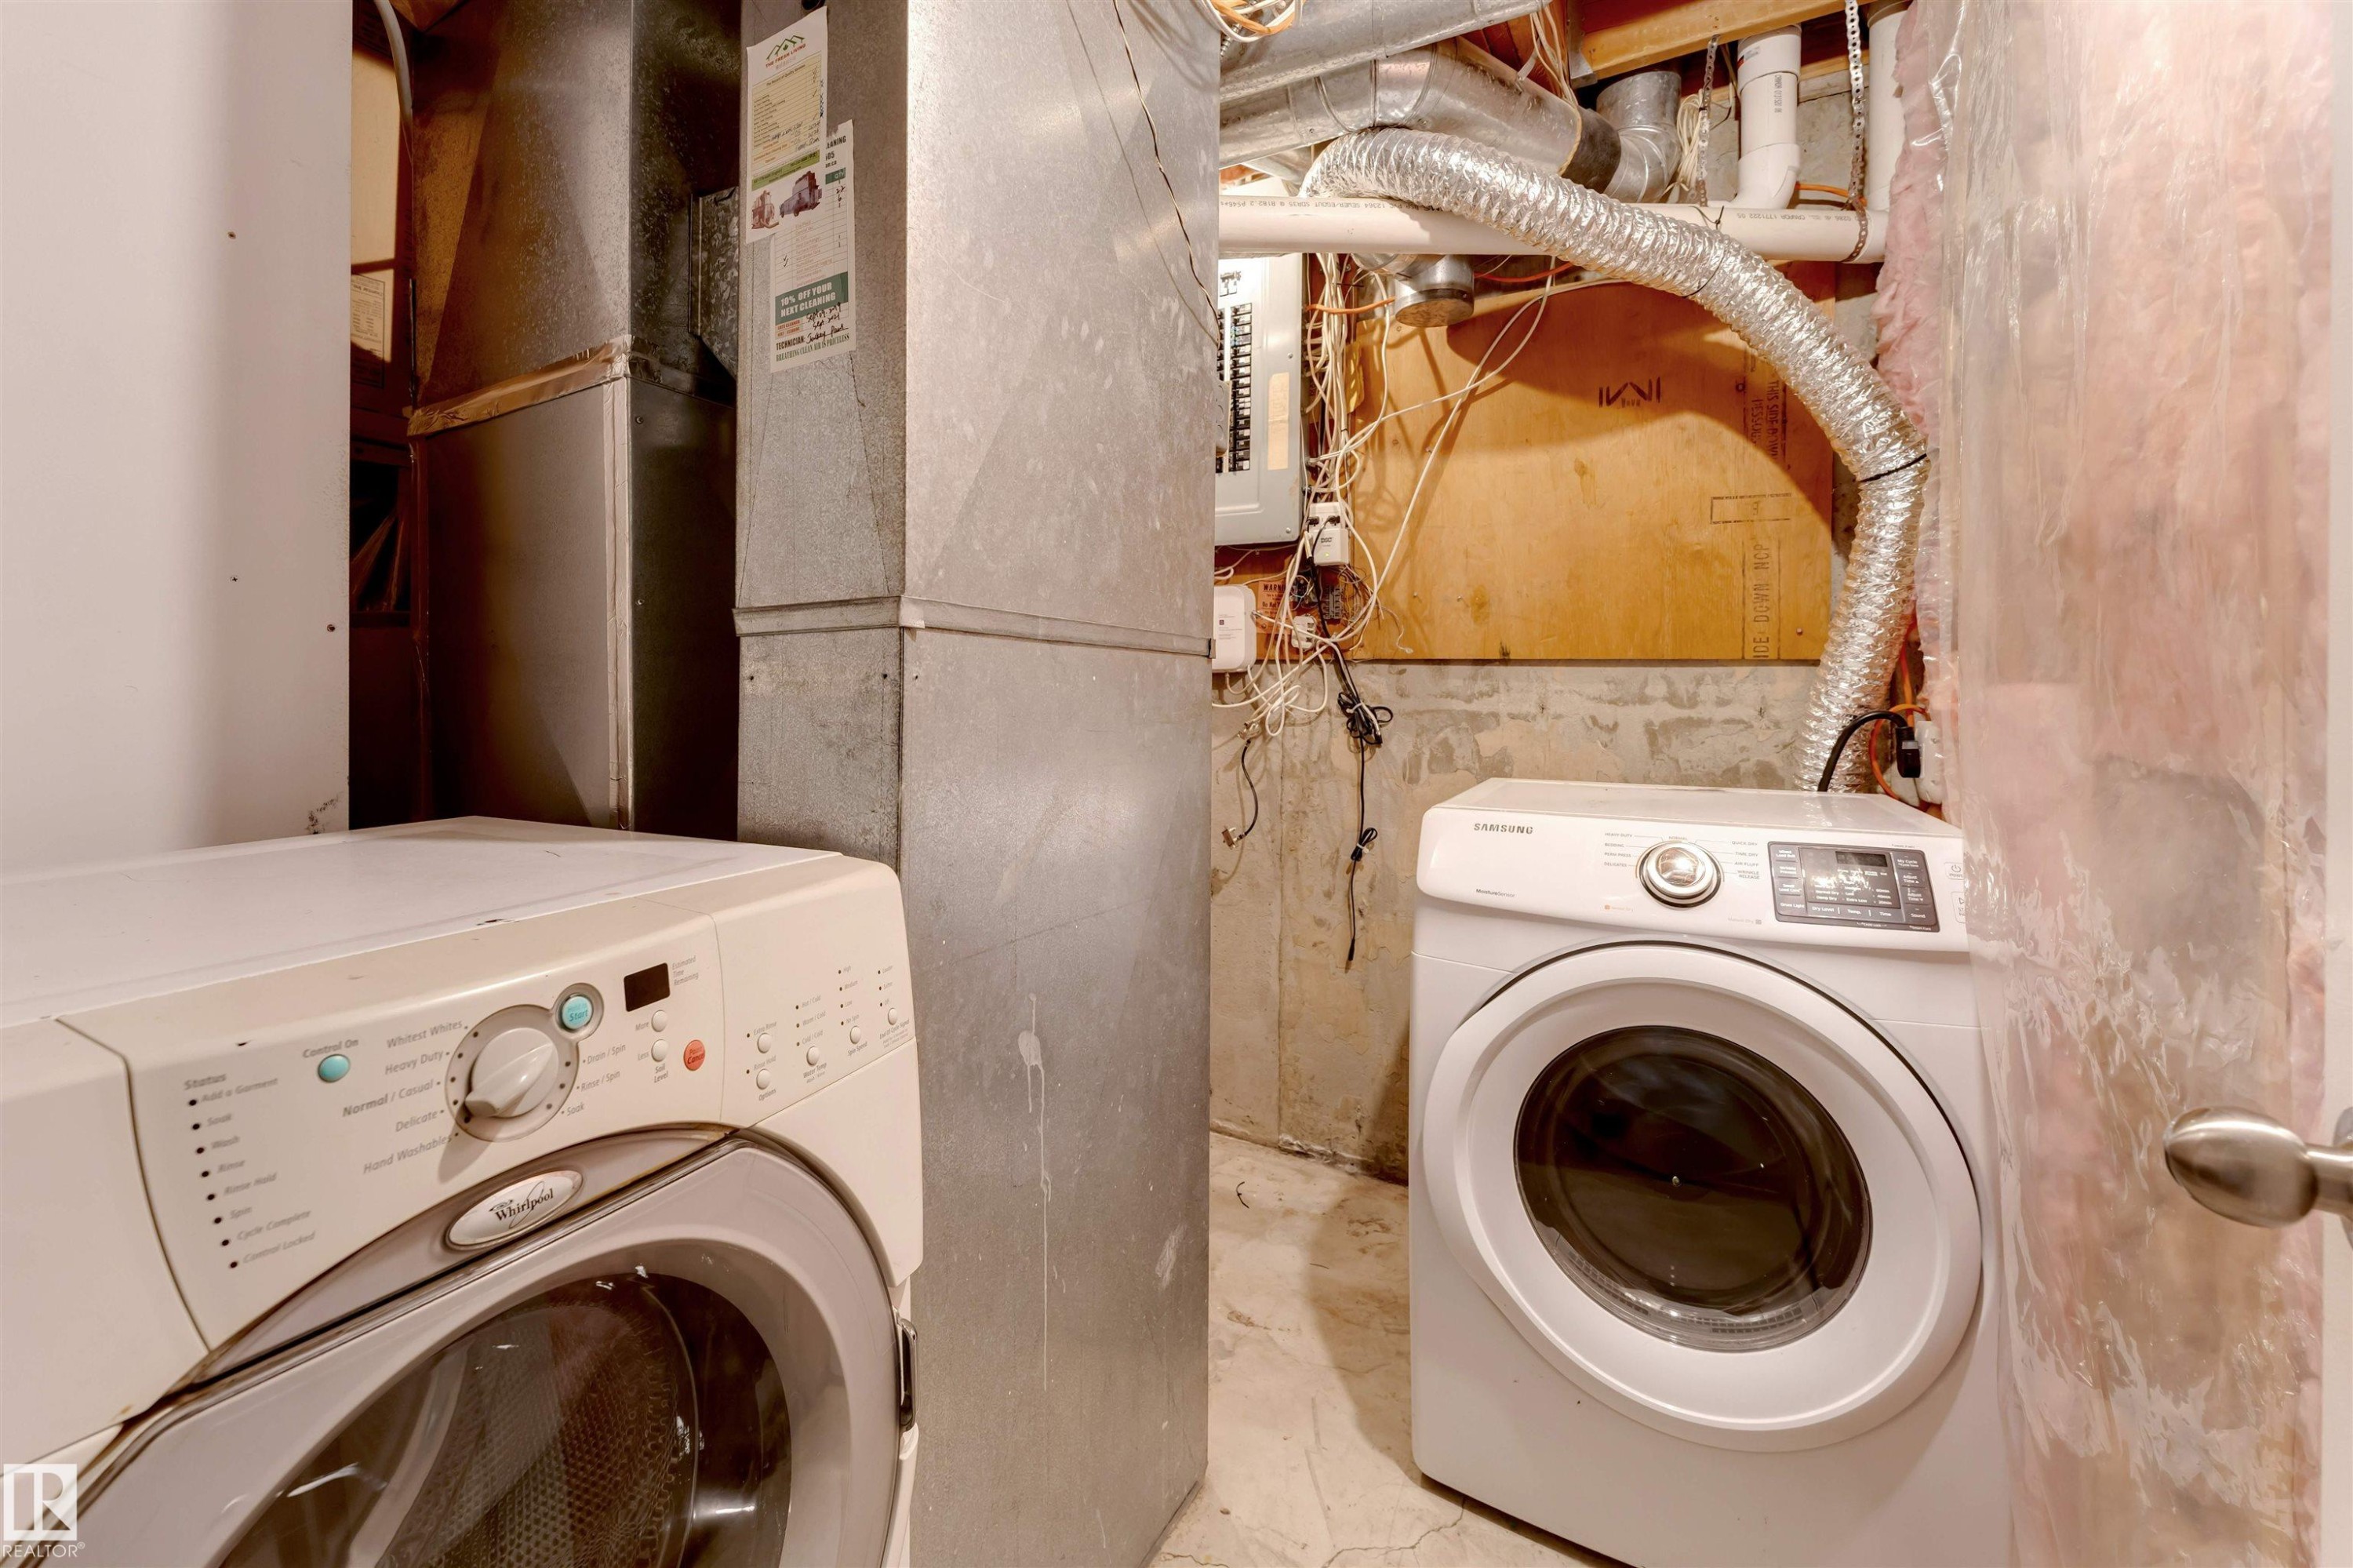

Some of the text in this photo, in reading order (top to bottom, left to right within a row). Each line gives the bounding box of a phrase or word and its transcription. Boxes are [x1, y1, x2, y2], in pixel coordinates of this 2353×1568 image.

[775, 53, 790, 63] FRESH
[791, 43, 806, 55] LIVING
[780, 282, 832, 307] 10% OFF YOUR
[780, 292, 836, 318] NEXT CLEANING
[776, 348, 800, 362] BREATHING
[800, 344, 813, 355] CLEAN
[827, 333, 850, 347] PRICELESS
[1767, 380, 1779, 402] THIS
[1753, 544, 1770, 570] NCP
[1753, 584, 1770, 623] DOWN
[1474, 823, 1534, 835] SAMSUNG
[1475, 888, 1515, 898] MoistureSensor
[672, 955, 696, 970] Estimated
[673, 970, 685, 978] Time
[673, 972, 699, 986] Remaining
[844, 980, 858, 990] Medium
[812, 995, 821, 1003] Cold
[569, 1010, 588, 1022] Start
[802, 1010, 827, 1026] Warm Cold
[387, 1020, 463, 1048] Whitest Whites
[635, 1021, 649, 1031] More
[753, 1021, 777, 1037] Extra Rinse
[891, 1024, 900, 1035] Cycle
[900, 1019, 910, 1028] Signal
[802, 1029, 824, 1045] Cold Cold
[303, 1039, 359, 1058] Control On
[587, 1043, 626, 1064] Drain Spin
[638, 1051, 649, 1060] Less
[848, 1041, 868, 1057] Spin Speed
[384, 1050, 444, 1075] Heavy Duty
[687, 1052, 705, 1064] Cance
[754, 1056, 776, 1070] Rinse Hold
[653, 1070, 668, 1083] Level
[655, 1064, 666, 1074] Soil
[803, 1061, 827, 1079] Water Temp
[184, 1073, 227, 1090] Status
[580, 1070, 620, 1092] Rinse Spin
[202, 1090, 224, 1102] Add
[235, 1078, 278, 1094] Garment
[342, 1093, 387, 1117] Normal
[398, 1079, 434, 1099] Casual
[758, 1089, 776, 1101] Options
[566, 1103, 584, 1116] Soak
[207, 1112, 231, 1126] Soak
[395, 1110, 438, 1132] Delicate
[211, 1135, 240, 1149] Wash
[363, 1135, 452, 1174] Hand Washables
[218, 1159, 245, 1173] Rinse
[224, 1172, 278, 1195] Rinse Hold
[231, 1206, 252, 1219] Spin
[494, 1188, 554, 1221] Whirlpool
[237, 1210, 311, 1240] Cycle Complete
[242, 1230, 316, 1264] Control Locked
